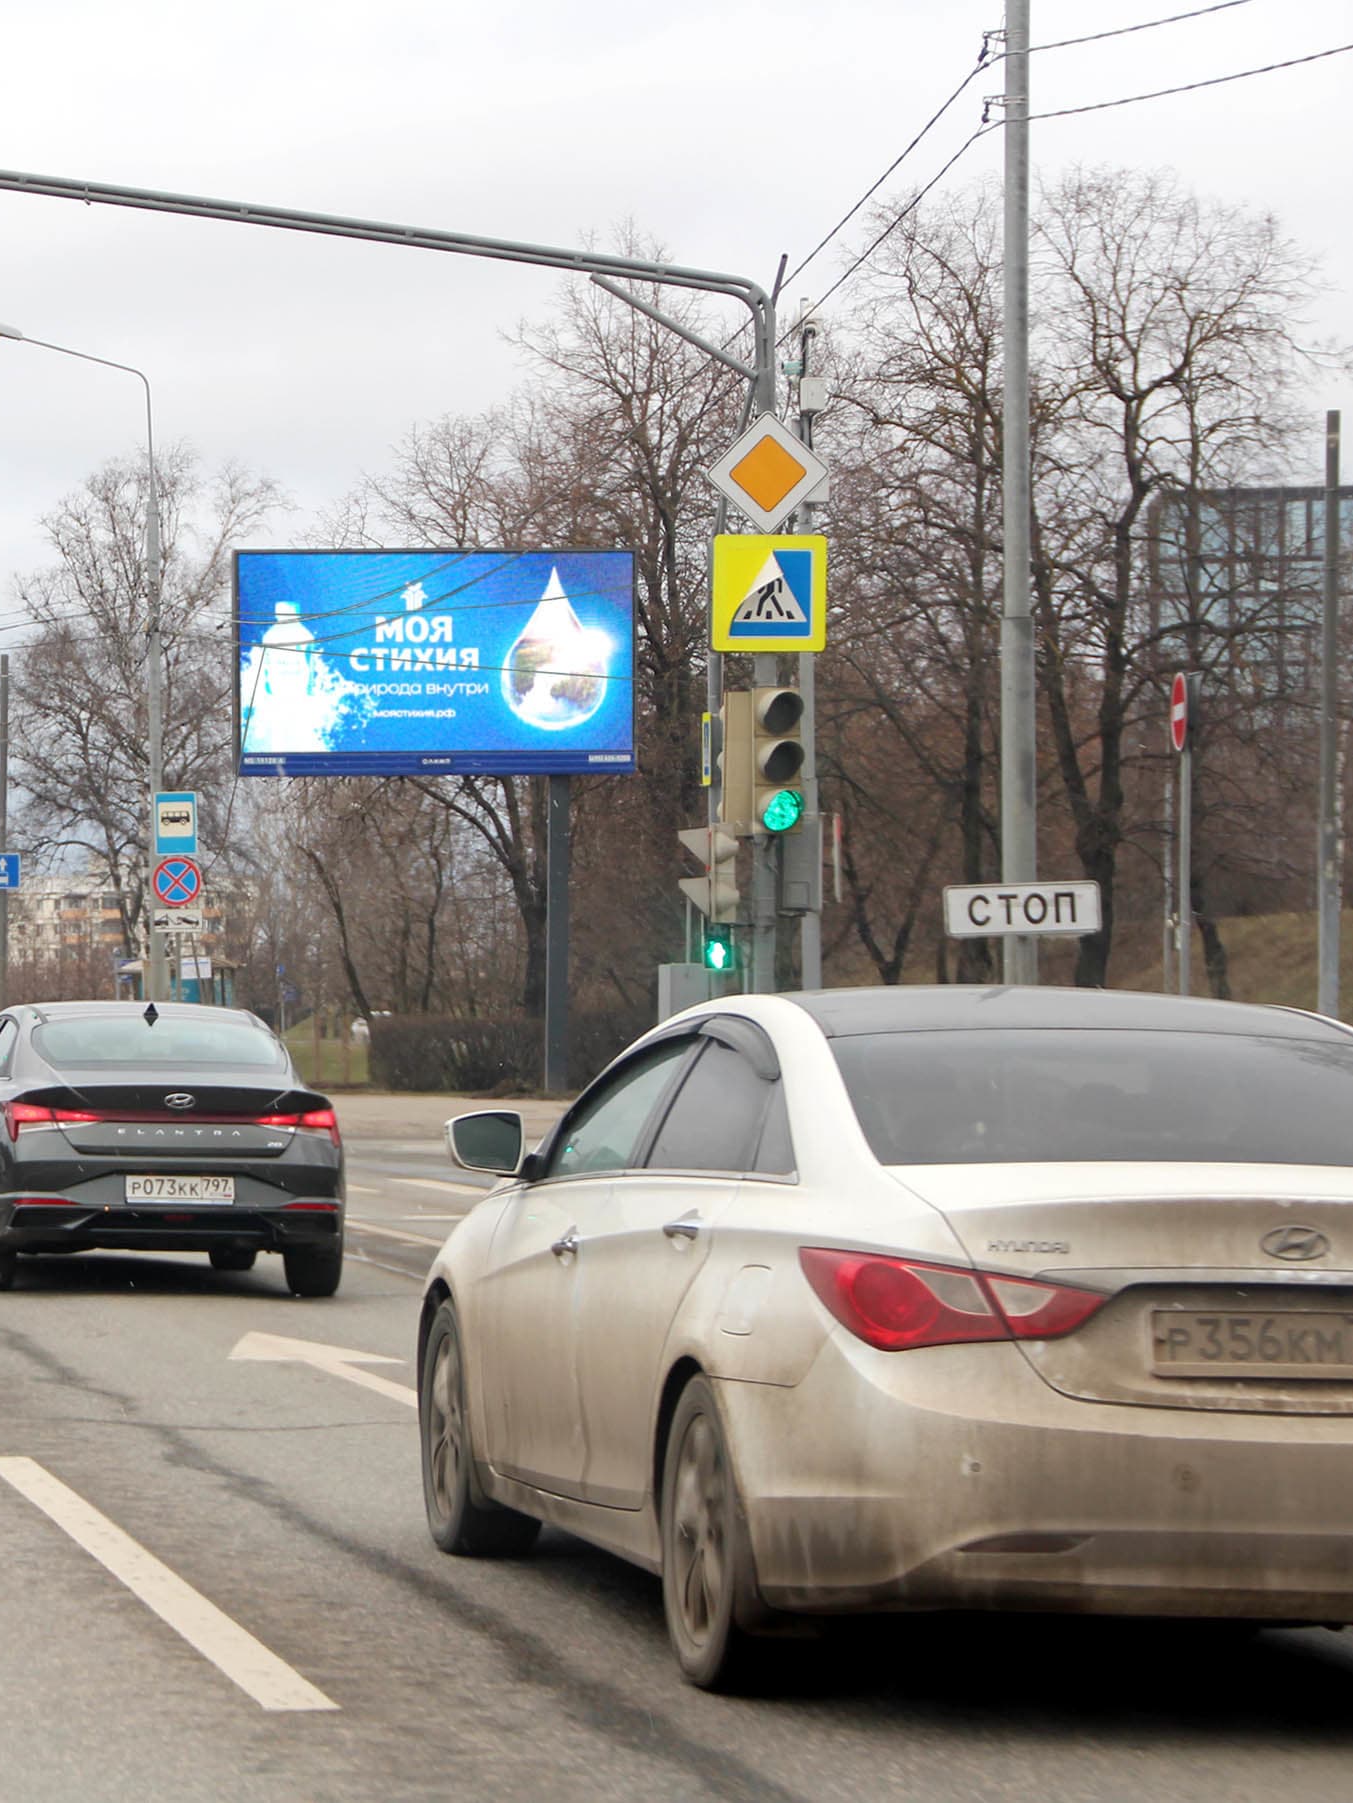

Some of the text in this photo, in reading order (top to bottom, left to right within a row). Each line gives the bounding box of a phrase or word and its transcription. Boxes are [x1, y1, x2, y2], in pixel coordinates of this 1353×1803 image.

[375, 615, 453, 643] МОЯ
[349, 647, 480, 672] СТИХИЯ
[426, 682, 489, 697] внутри
[968, 892, 1077, 927] СТОП
[117, 1128, 241, 1136] ELANTRA
[203, 1178, 229, 1192] 797
[987, 1240, 1070, 1255] HYUNDAI
